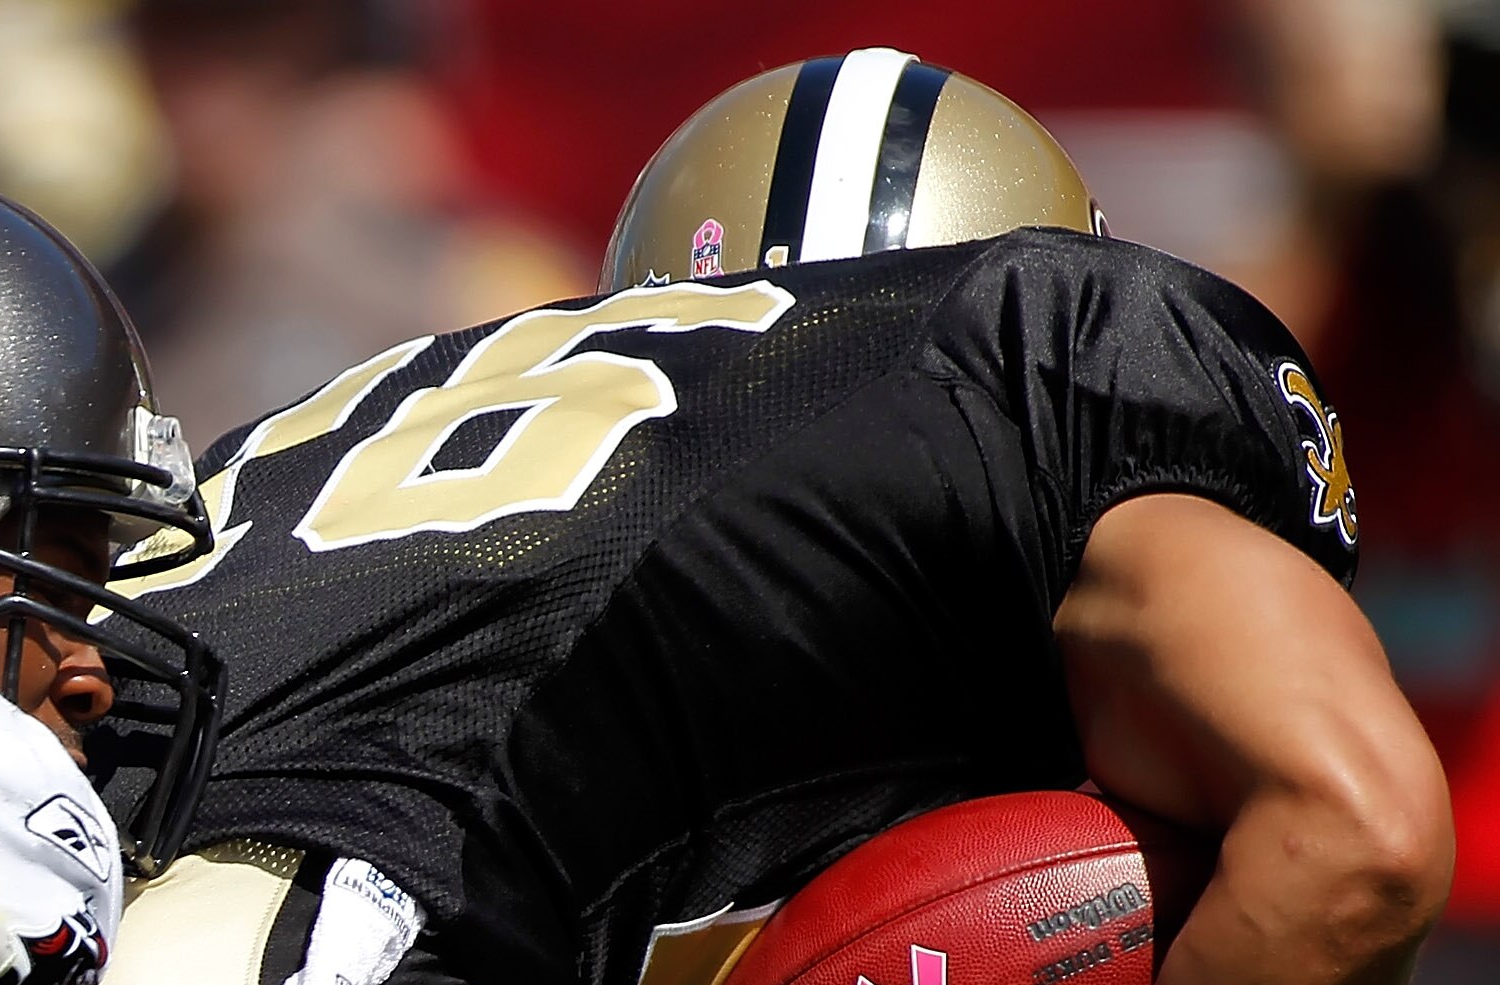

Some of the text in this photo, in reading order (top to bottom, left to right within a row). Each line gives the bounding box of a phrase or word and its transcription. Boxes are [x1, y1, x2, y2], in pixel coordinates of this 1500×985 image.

[694, 255, 717, 276] NFL
[1026, 882, 1149, 942] Wilson
[1119, 923, 1154, 952] HE
